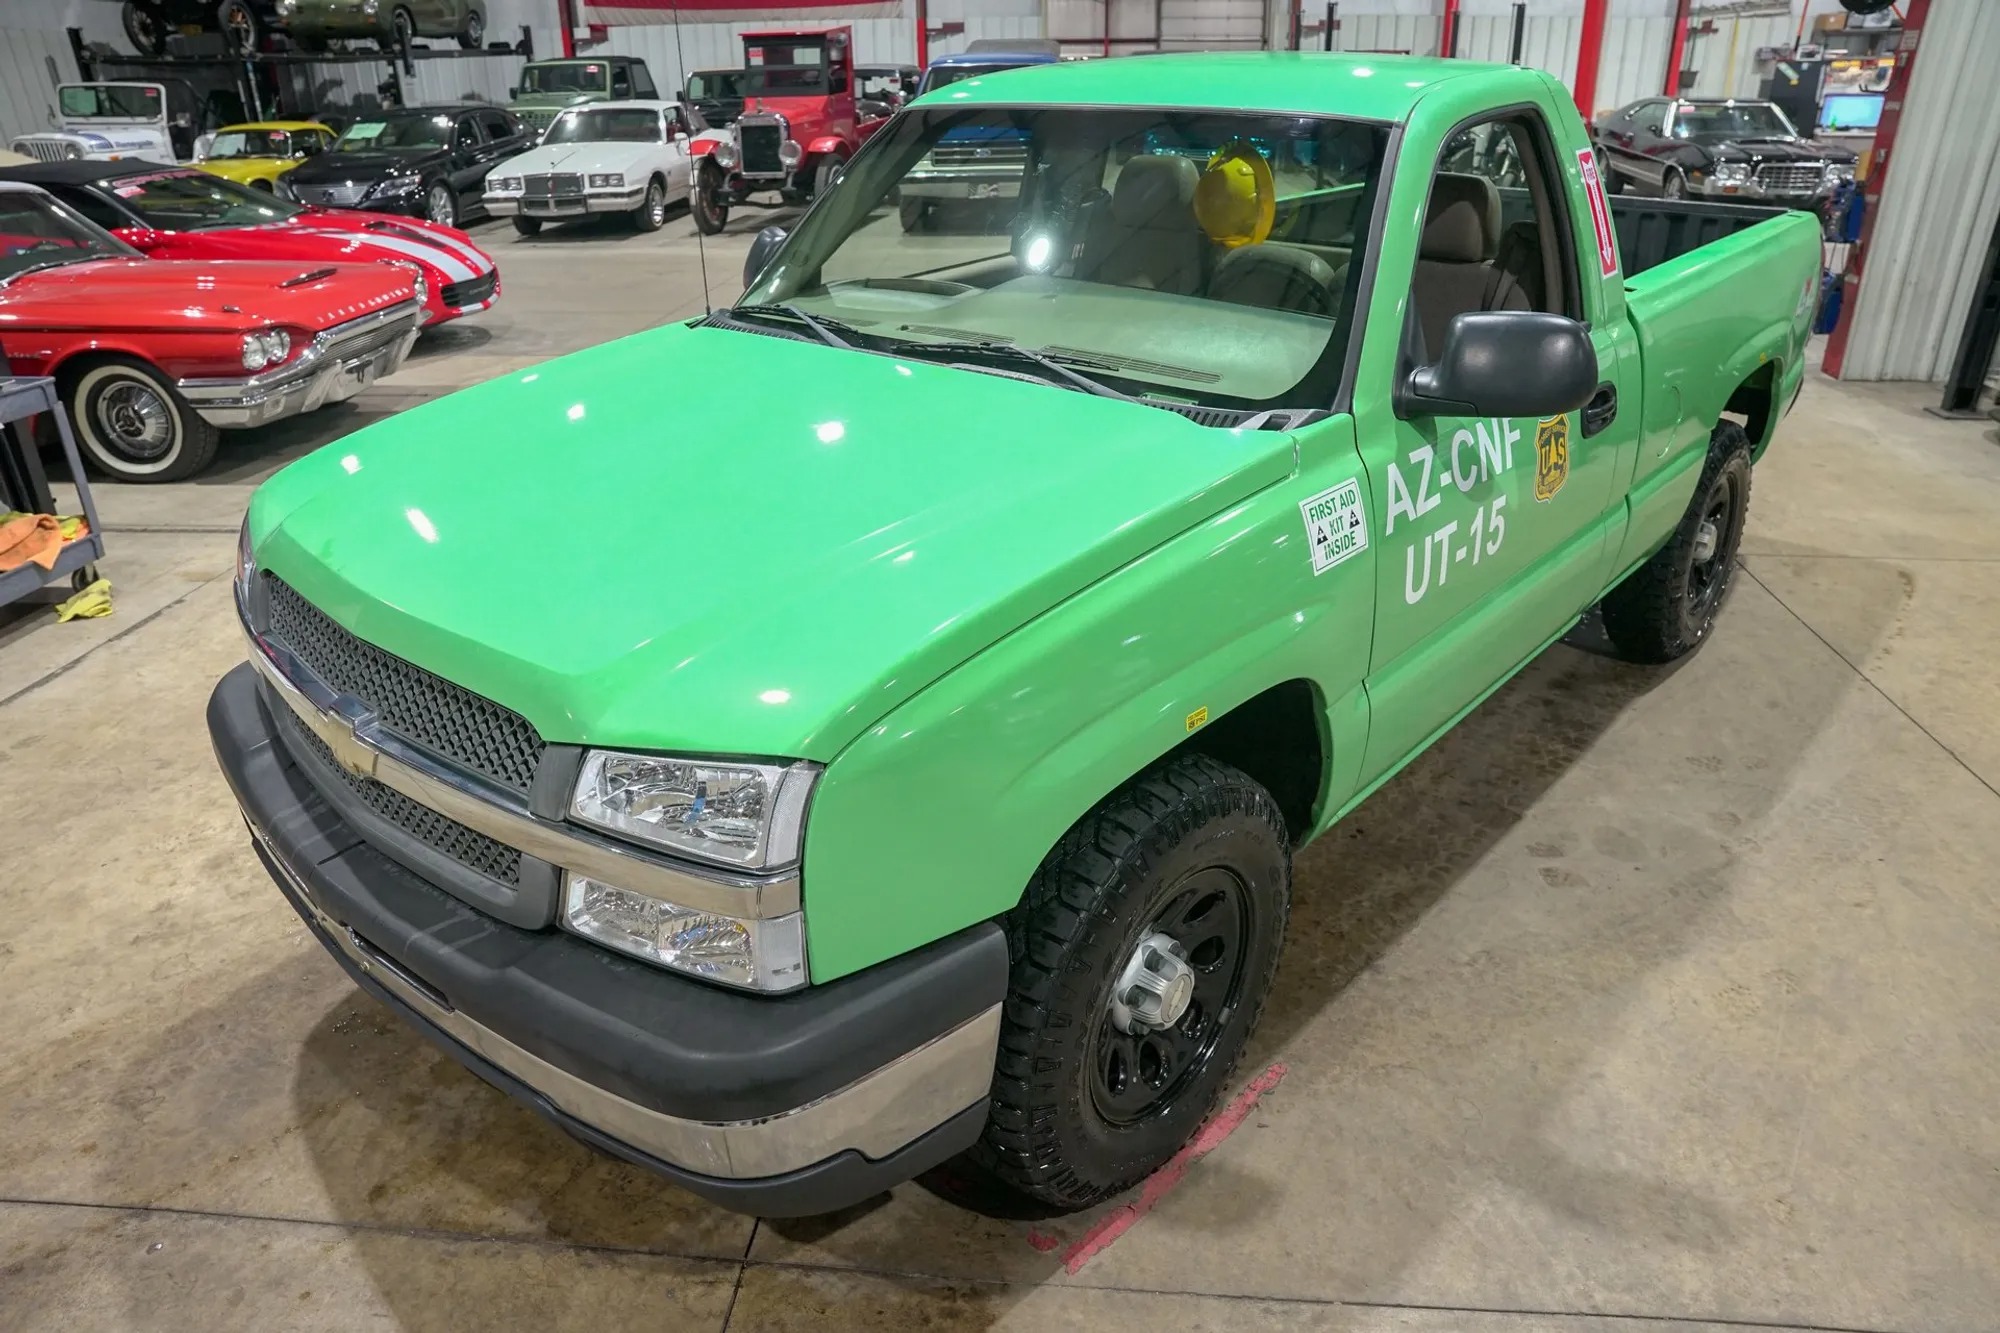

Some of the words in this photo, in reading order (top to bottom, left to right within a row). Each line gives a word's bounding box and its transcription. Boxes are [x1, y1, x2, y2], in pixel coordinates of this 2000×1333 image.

[1386, 417, 1520, 536] AZ-CNF
[1309, 497, 1338, 524] FIRST
[1339, 489, 1356, 511] AID
[1329, 515, 1345, 537] KIT
[1323, 530, 1357, 560] INSIDE
[1405, 494, 1507, 605] UT-15
